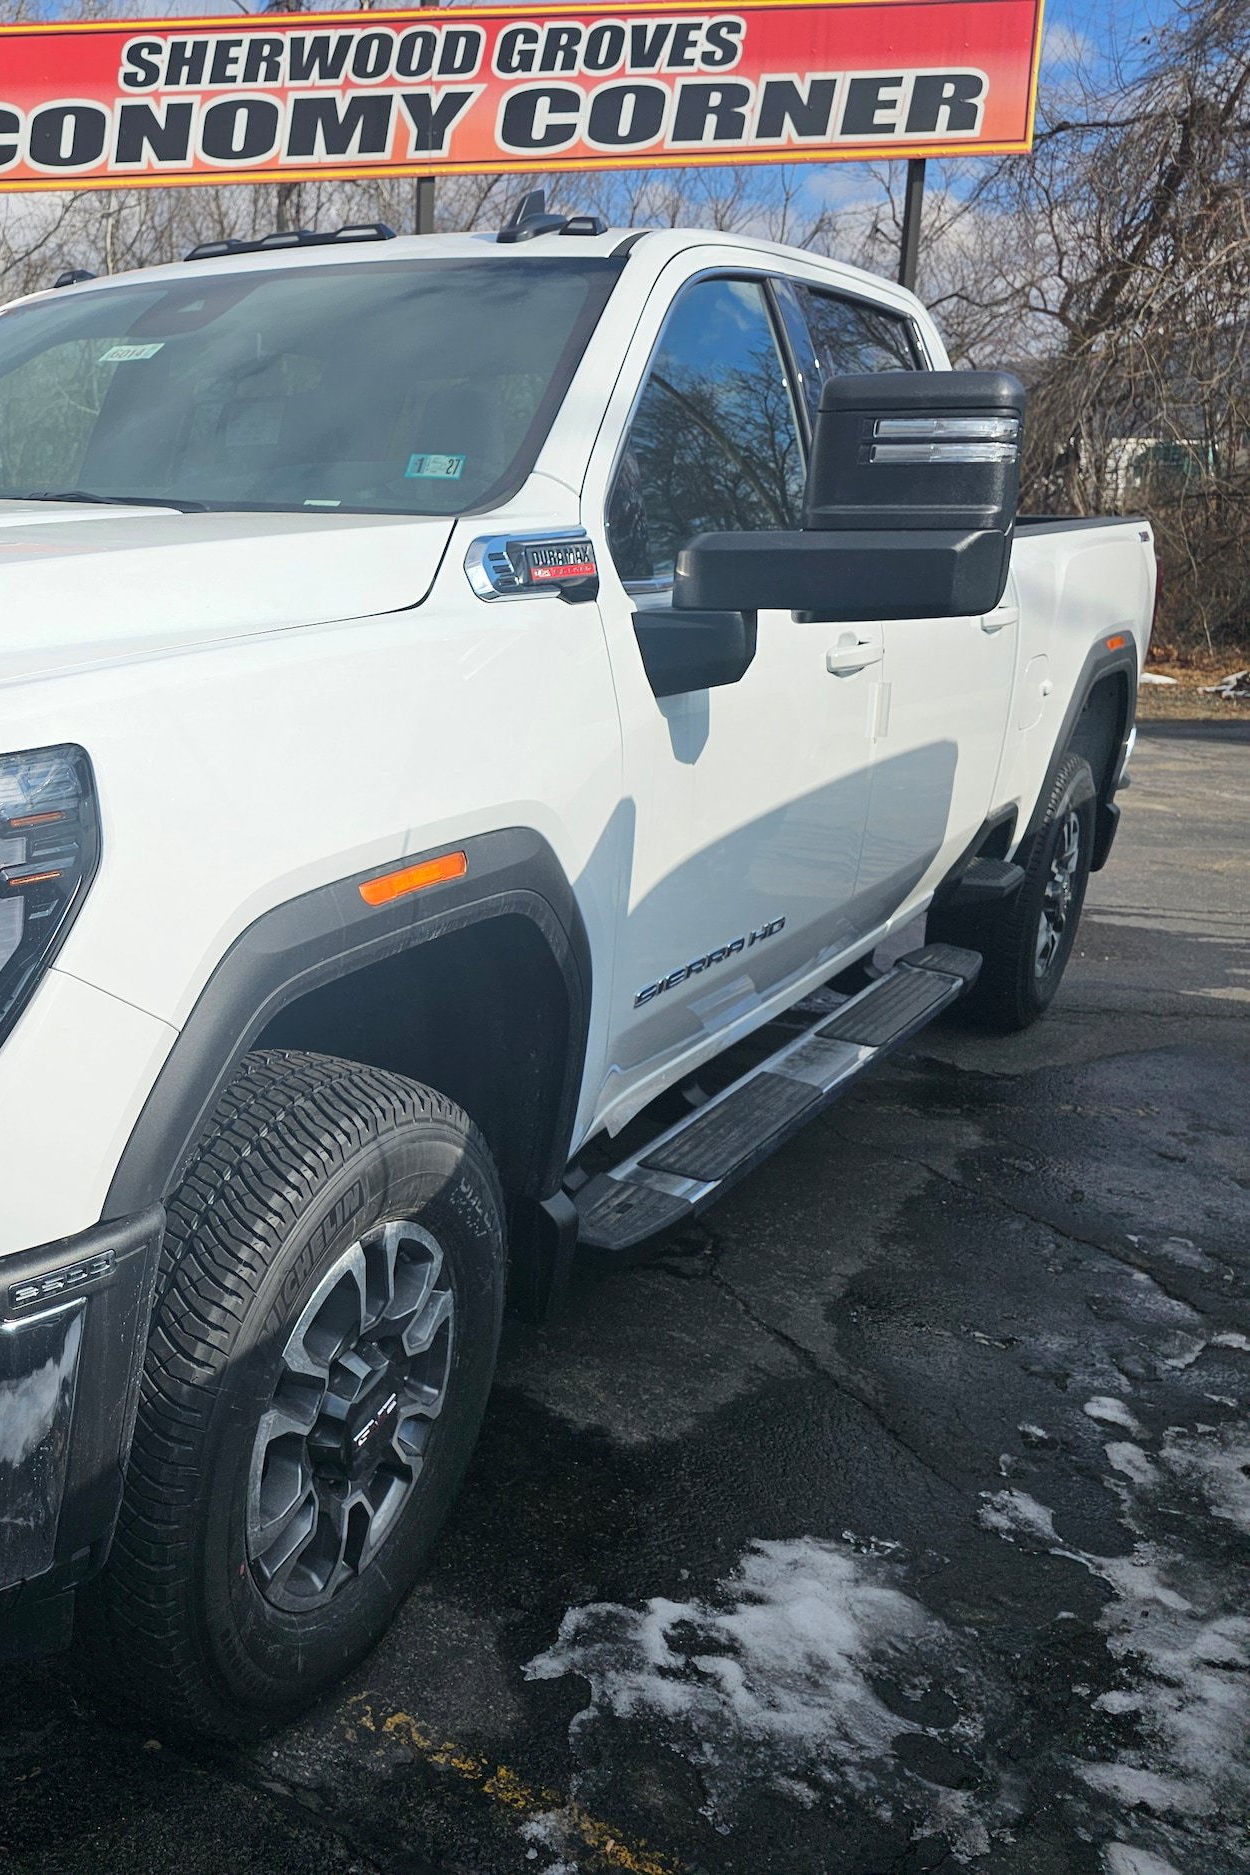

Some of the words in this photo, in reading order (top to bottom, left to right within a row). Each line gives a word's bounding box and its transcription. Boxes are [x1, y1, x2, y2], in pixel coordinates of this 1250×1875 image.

[123, 28, 482, 88] SHERWOOD
[497, 21, 741, 72] GROVES
[500, 73, 985, 149] CORNER
[446, 458, 461, 475] 27
[532, 546, 592, 566] DURAMAX
[633, 936, 745, 1009] SIERRA
[747, 916, 786, 948] HD
